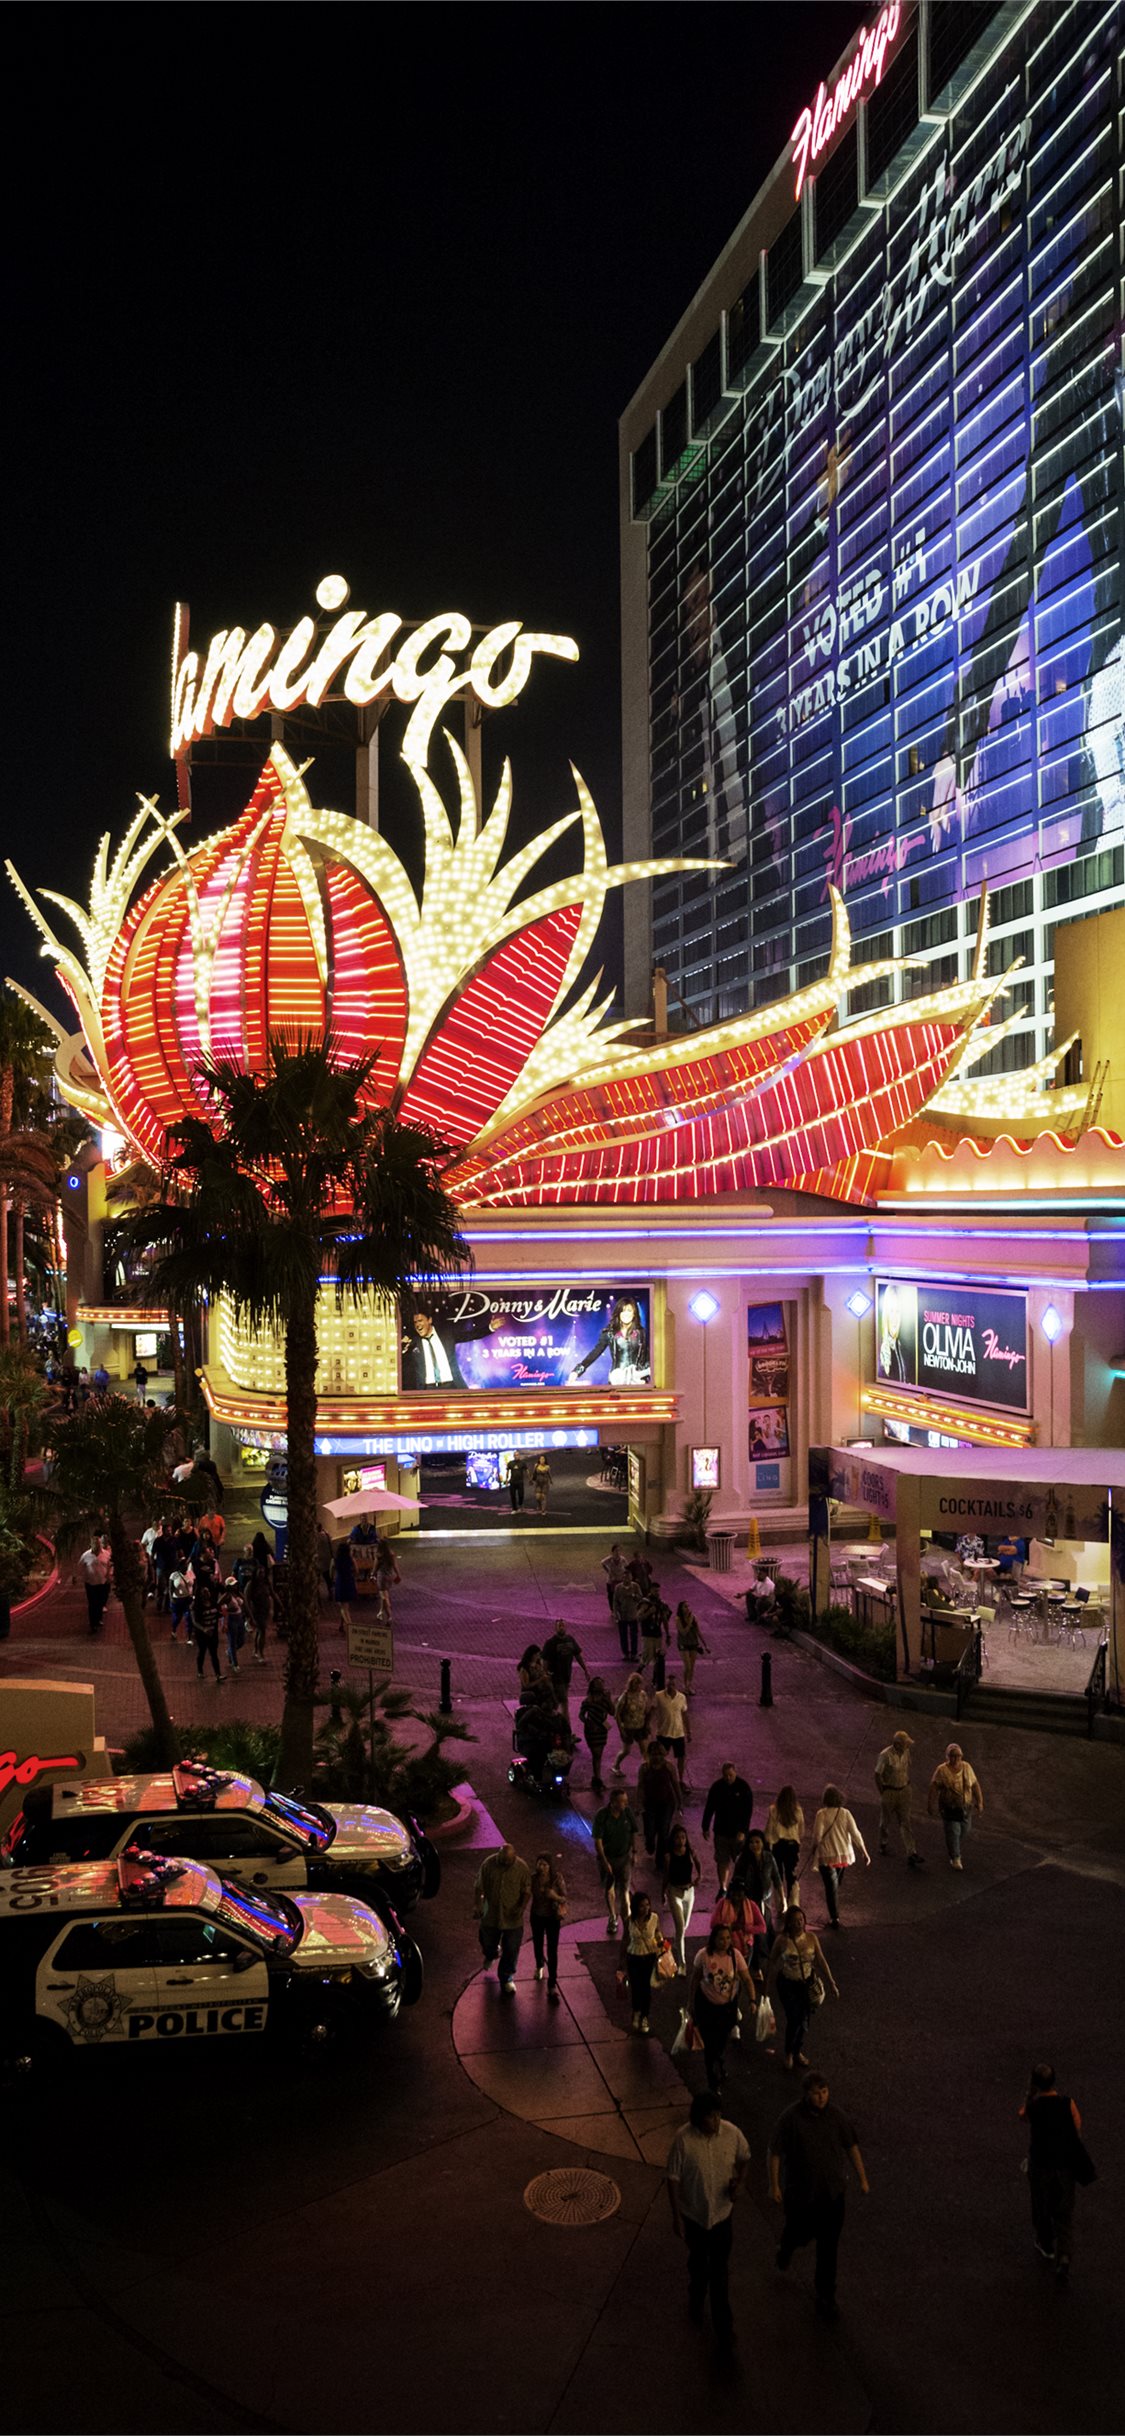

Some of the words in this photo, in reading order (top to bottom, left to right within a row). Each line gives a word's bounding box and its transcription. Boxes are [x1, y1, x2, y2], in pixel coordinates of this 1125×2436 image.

[788, 0, 901, 203] Flamingo
[803, 569, 884, 667] VOTED
[893, 527, 927, 599] #1
[776, 707, 787, 745] 3
[791, 660, 851, 732] YEARS
[855, 636, 882, 689] IN
[885, 620, 905, 668] A
[912, 562, 980, 650] ROW
[812, 805, 926, 903] Flamingo
[447, 1290, 536, 1323] Donny
[511, 1288, 602, 1323] Marie
[533, 1299, 544, 1312] &
[924, 1311, 950, 1325] SUMMER
[951, 1313, 975, 1329] NIGHTS
[482, 1348, 490, 1359] 3
[491, 1348, 521, 1359] YEARS
[524, 1348, 535, 1359] IN
[537, 1348, 545, 1357] A
[547, 1347, 571, 1358] ROW
[498, 1336, 537, 1347] VOTED
[540, 1336, 553, 1346] #1
[981, 1328, 1026, 1371] Flamingo
[511, 1363, 555, 1381] Flamingo
[924, 1353, 976, 1375] NEWTON-JOHN
[363, 1438, 394, 1455] THE
[397, 1436, 432, 1454] LINQ
[447, 1434, 486, 1452] HIGH
[488, 1431, 545, 1449] ROLLER
[939, 1497, 1016, 1519] COCKTAILS
[1020, 1504, 1034, 1520] $6
[350, 1653, 391, 1667] PROHIBITED
[128, 2006, 264, 2039] POLICE
